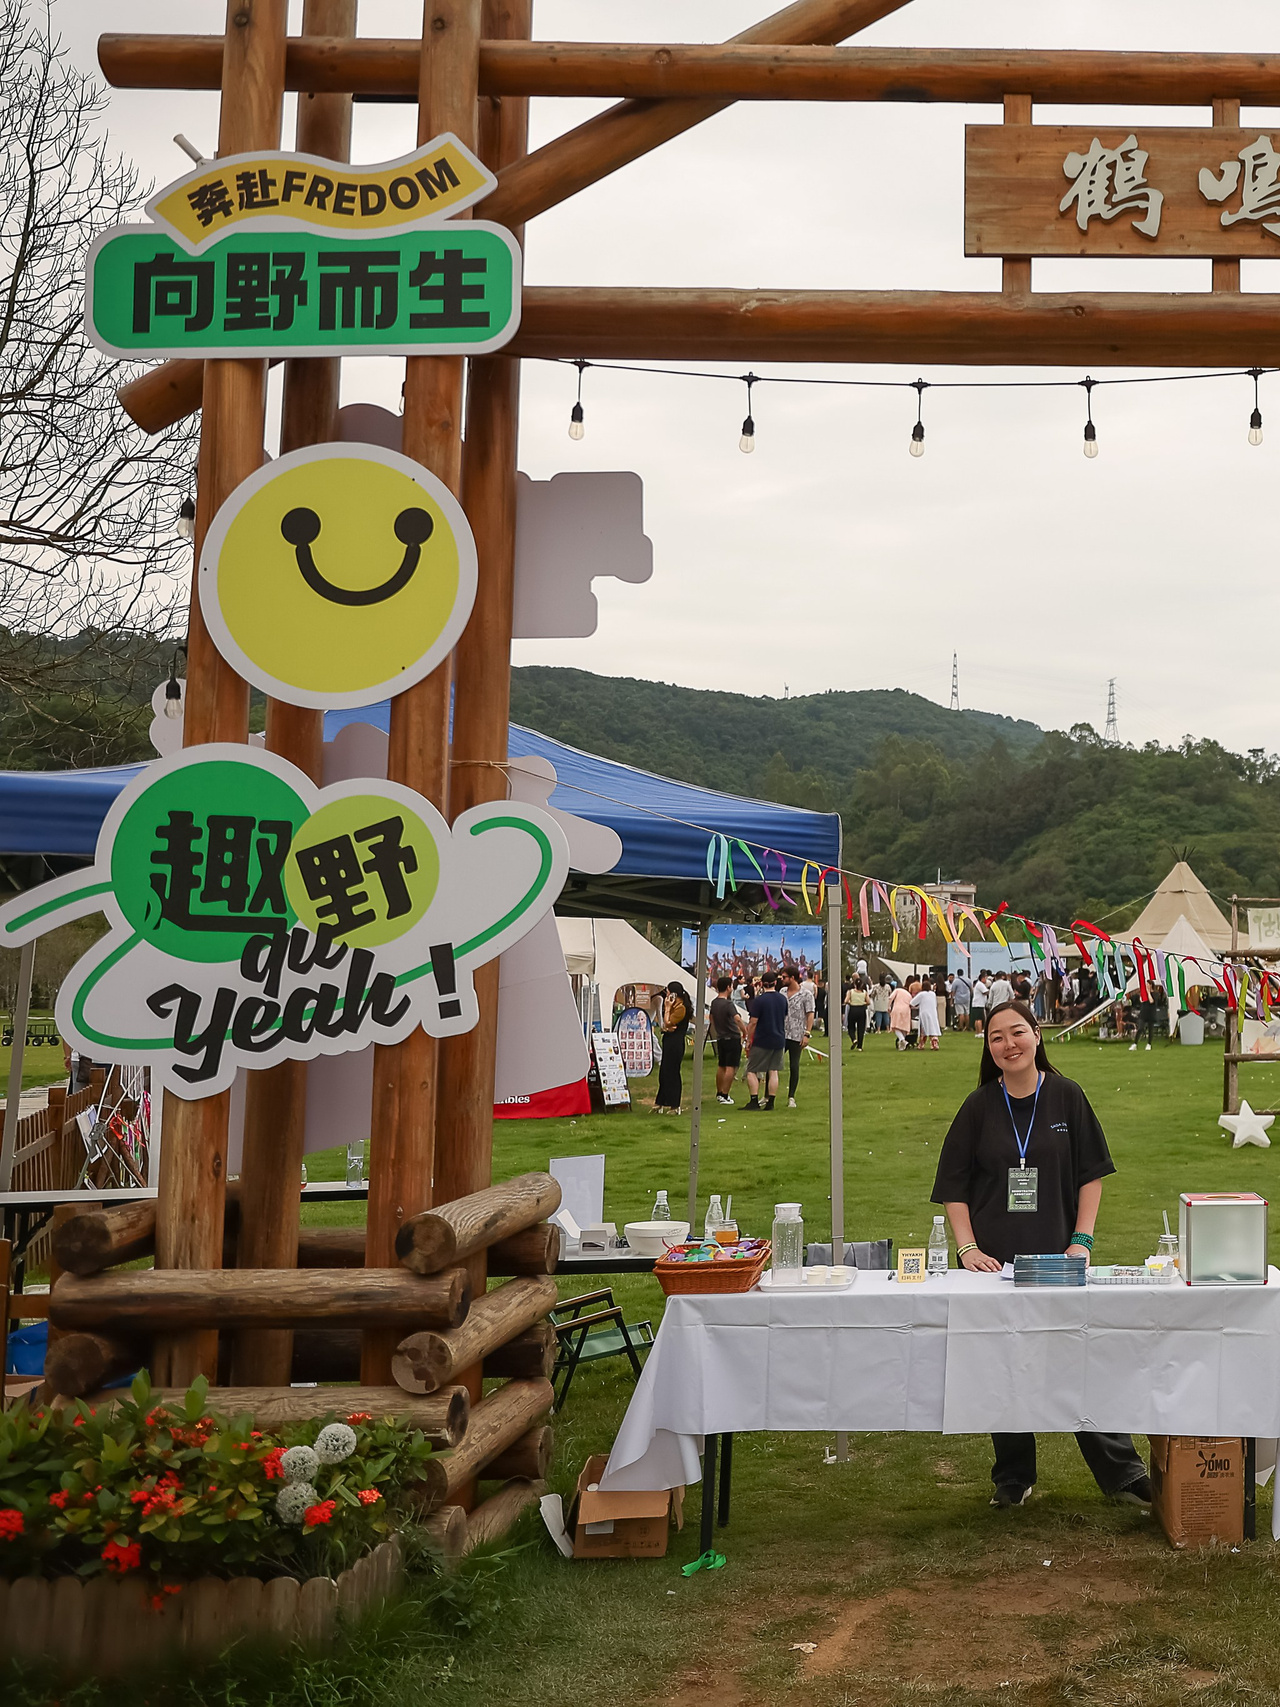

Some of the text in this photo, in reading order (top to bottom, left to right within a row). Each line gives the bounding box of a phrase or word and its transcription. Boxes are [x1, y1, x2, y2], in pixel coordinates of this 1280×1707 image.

[131, 249, 491, 334] 向野而生
[1207, 1458, 1230, 1471] OMO
